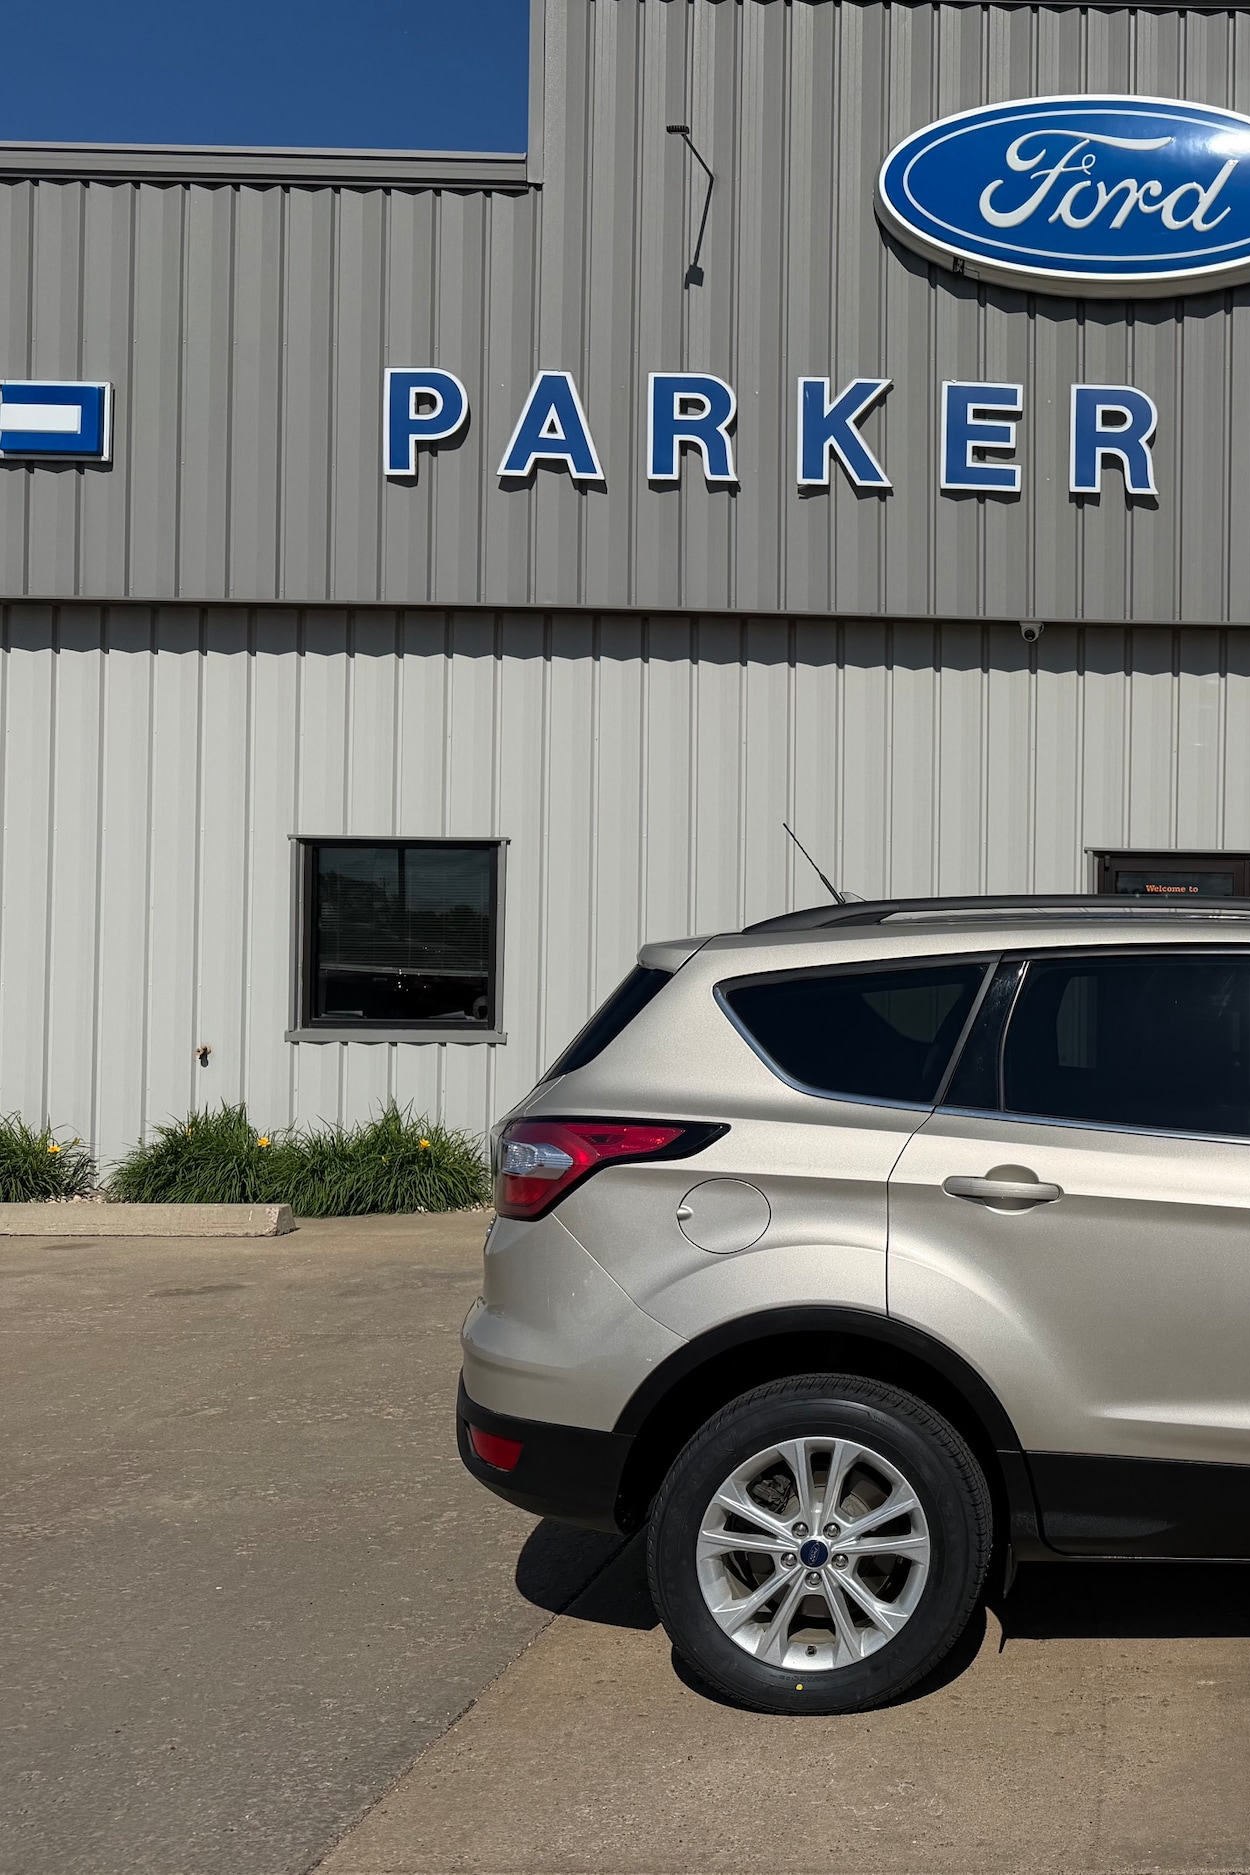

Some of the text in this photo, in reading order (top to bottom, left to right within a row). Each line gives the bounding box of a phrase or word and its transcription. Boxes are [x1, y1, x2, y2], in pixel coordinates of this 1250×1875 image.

[978, 129, 1240, 232] Ford
[383, 366, 1159, 496] PARKER
[1145, 884, 1199, 893] Welcome to
